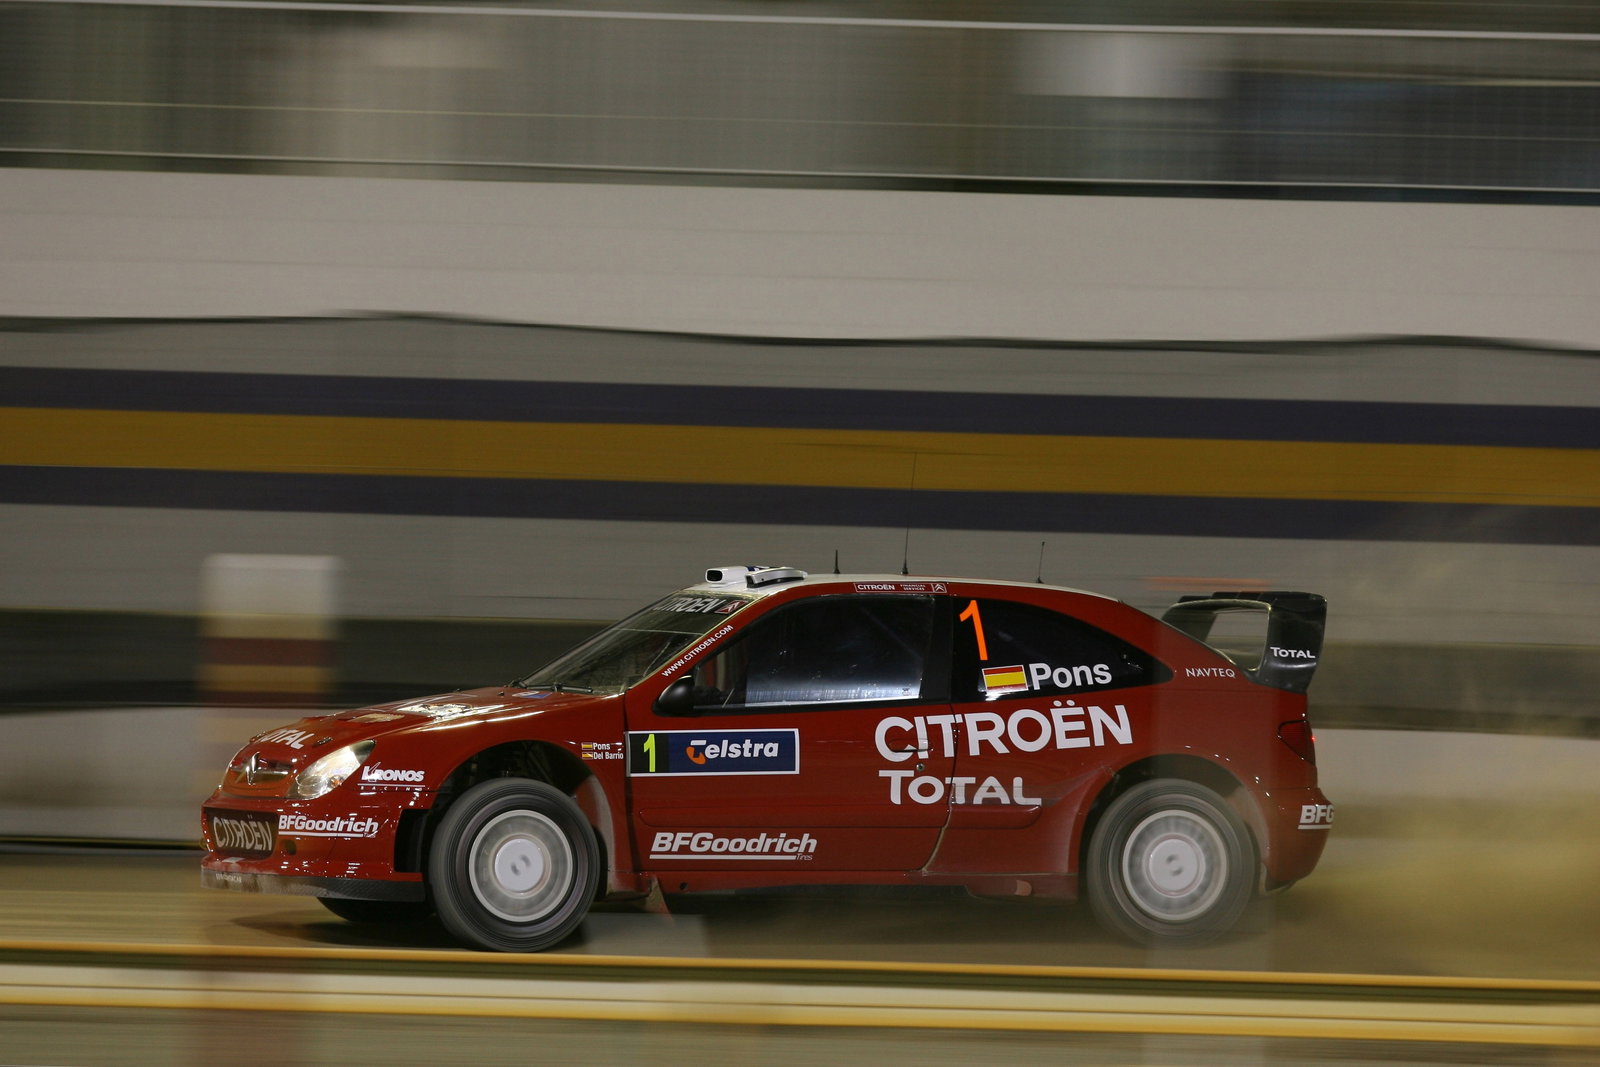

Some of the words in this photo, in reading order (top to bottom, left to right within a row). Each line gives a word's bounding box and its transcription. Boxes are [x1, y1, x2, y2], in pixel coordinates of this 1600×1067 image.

[959, 600, 988, 661] 1
[661, 625, 734, 677] WWW.CITROEN.COM
[1270, 646, 1316, 659] TOTAL
[1029, 662, 1112, 691] Pons
[1185, 667, 1236, 679] NAVTEQ
[874, 700, 1133, 762] CITROËN
[592, 742, 611, 750] Pons
[593, 752, 604, 760] Del
[605, 752, 624, 760] Barrio
[643, 734, 656, 772] 1
[686, 739, 779, 764] Telstra
[878, 770, 1042, 805] TOTAL
[278, 814, 379, 833] BFGoodrich
[651, 832, 818, 853] BFGoodrich
[795, 852, 814, 861] Tires
